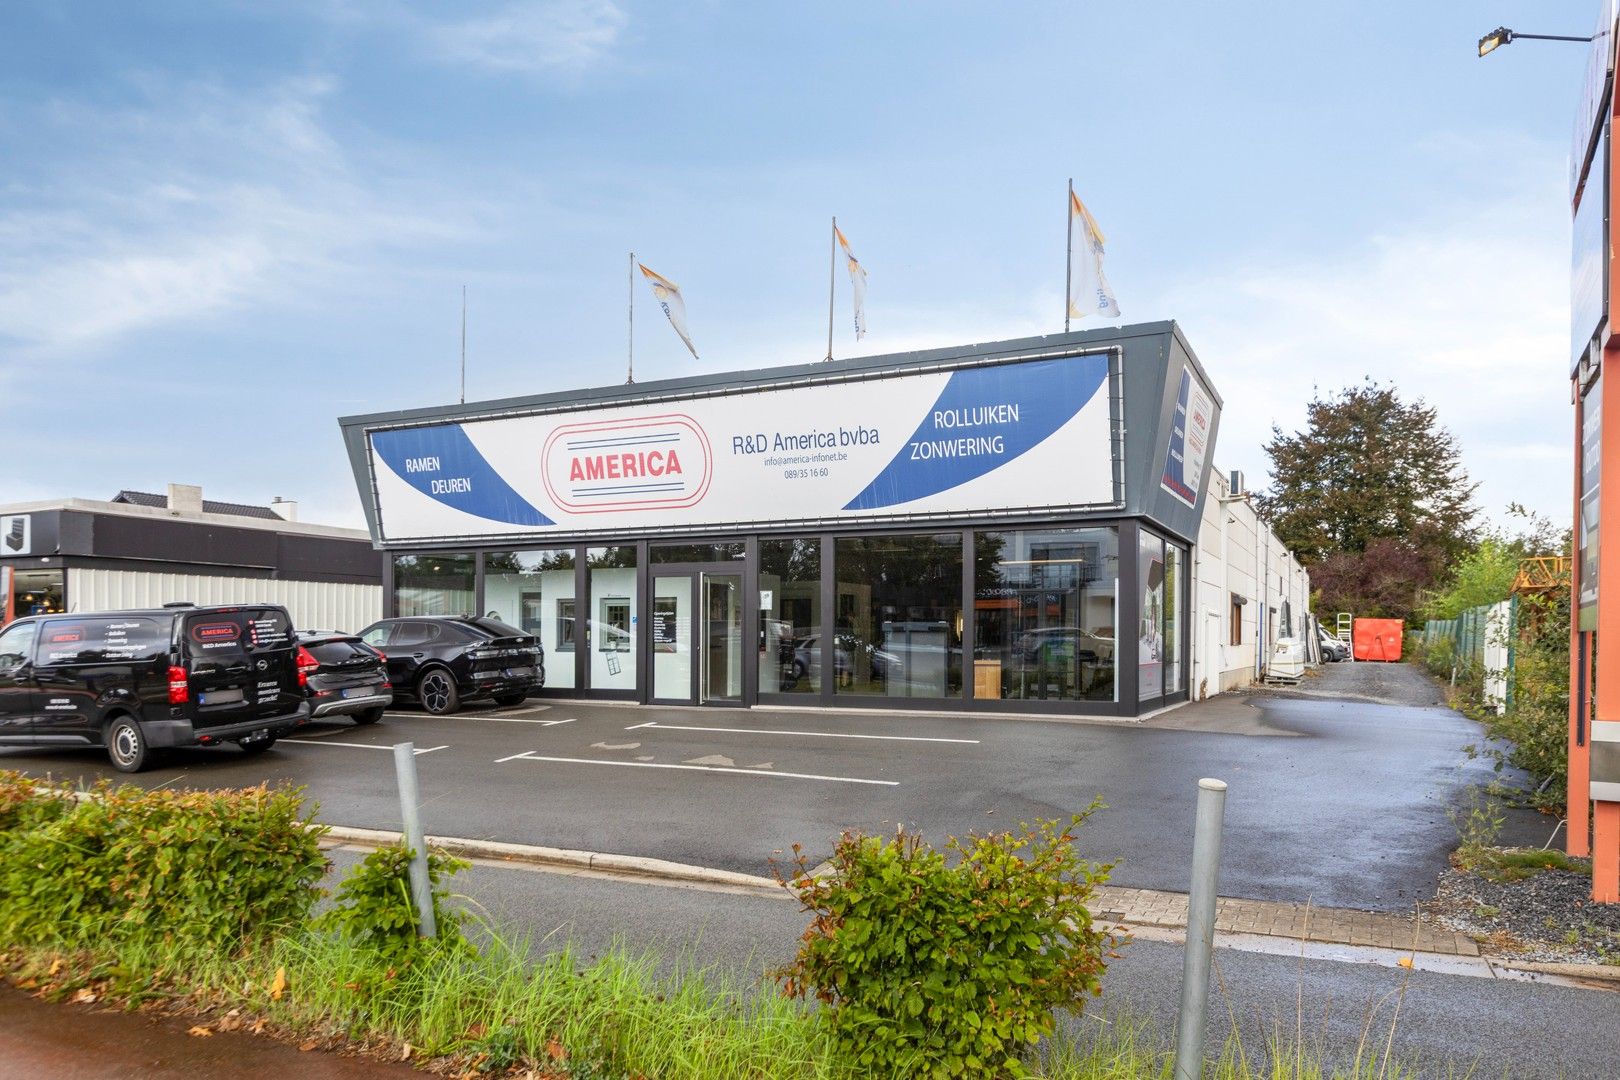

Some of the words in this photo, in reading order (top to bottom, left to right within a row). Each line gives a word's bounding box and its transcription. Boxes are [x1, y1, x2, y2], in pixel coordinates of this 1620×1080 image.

[934, 403, 1019, 429] ROLLUIKEN
[732, 434, 768, 455] R&D
[773, 429, 837, 452] America
[839, 425, 880, 446] bvba
[910, 436, 1004, 460] ZONWERING
[405, 457, 441, 473] RAMEN
[569, 449, 682, 482] AMERICA
[764, 452, 848, 466] info@america-infonet.be
[784, 468, 808, 479] 089/35
[810, 468, 819, 477] 16
[820, 467, 829, 477] 60
[431, 477, 471, 494] DEUREN
[201, 628, 234, 636] AMERICA
